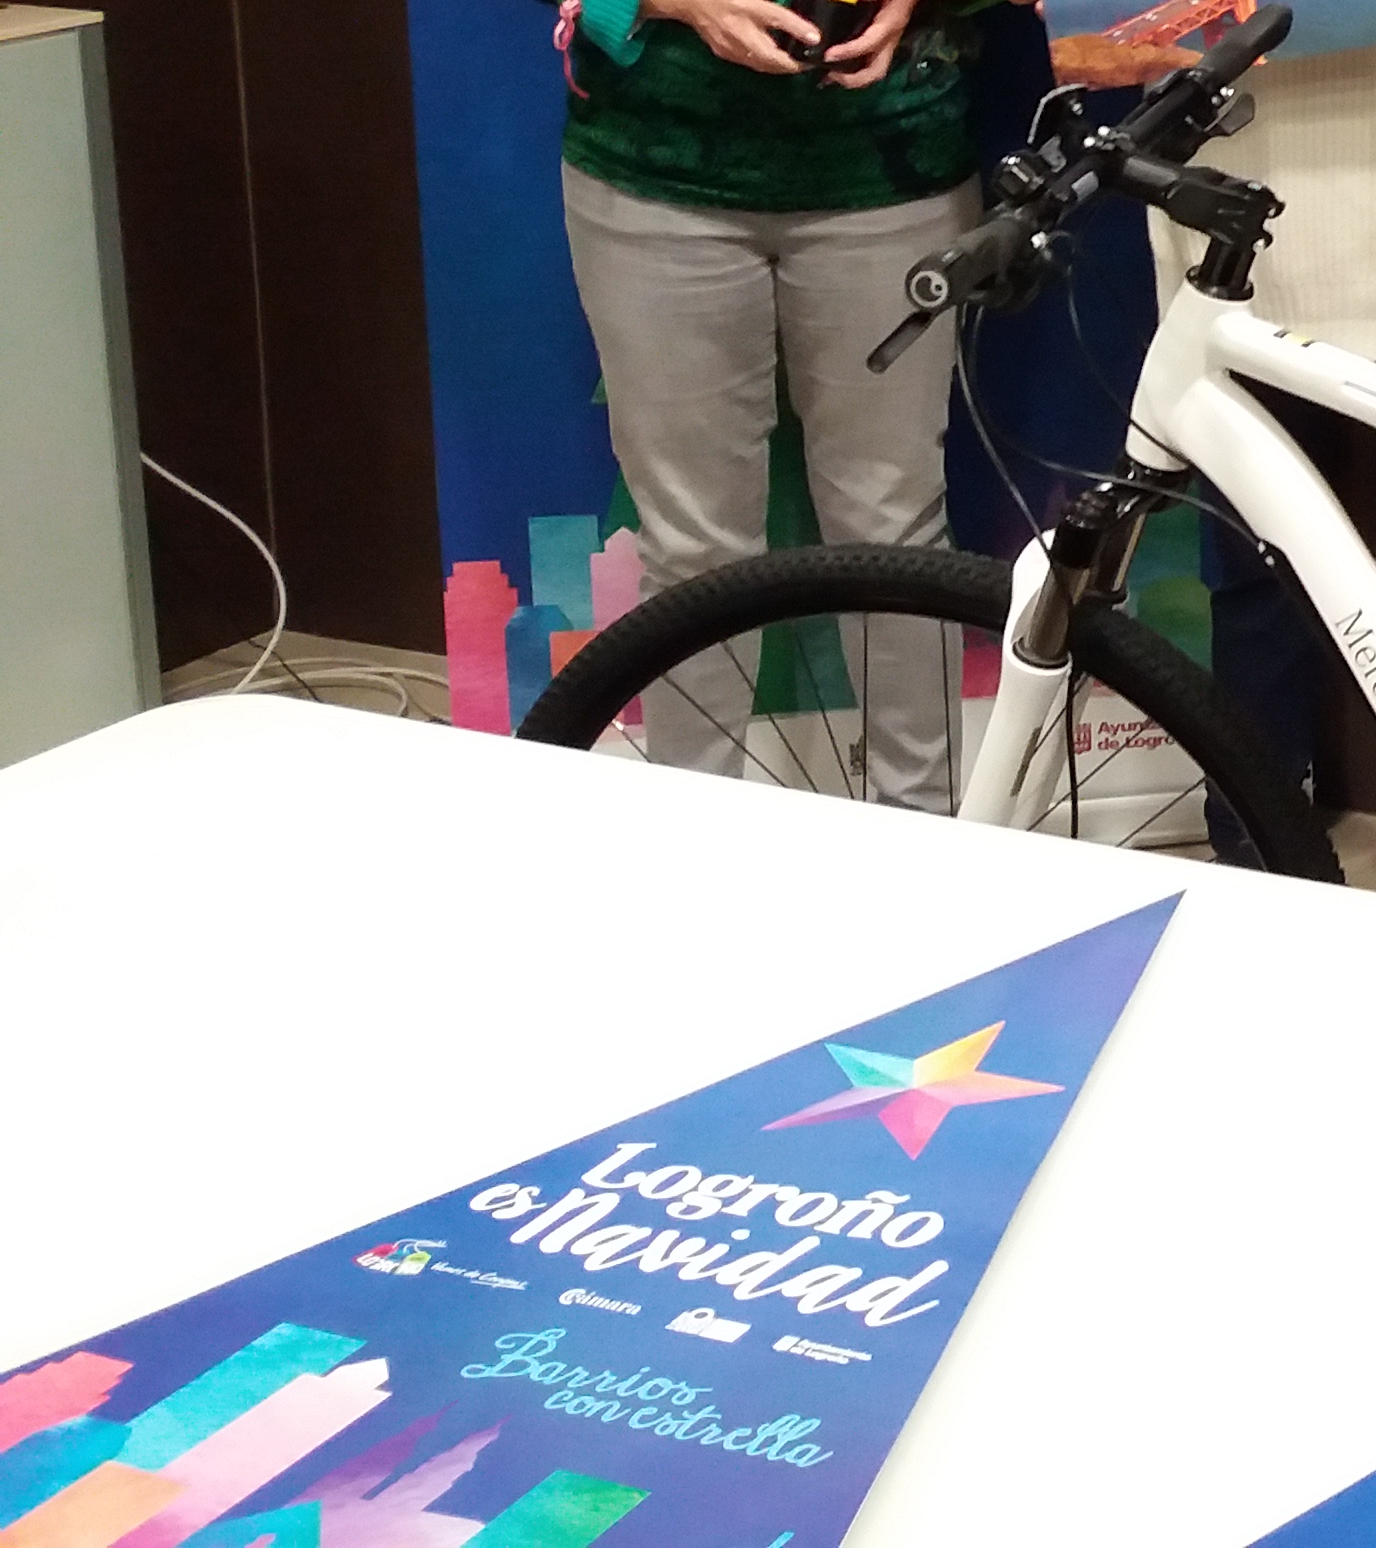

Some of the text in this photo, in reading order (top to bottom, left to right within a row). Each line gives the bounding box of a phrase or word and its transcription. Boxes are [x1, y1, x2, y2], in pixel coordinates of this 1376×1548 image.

[580, 1141, 945, 1249] Logroño
[468, 1181, 951, 1327] es Navidad
[460, 1327, 714, 1406] Barrios
[545, 1385, 835, 1468] con estrella
